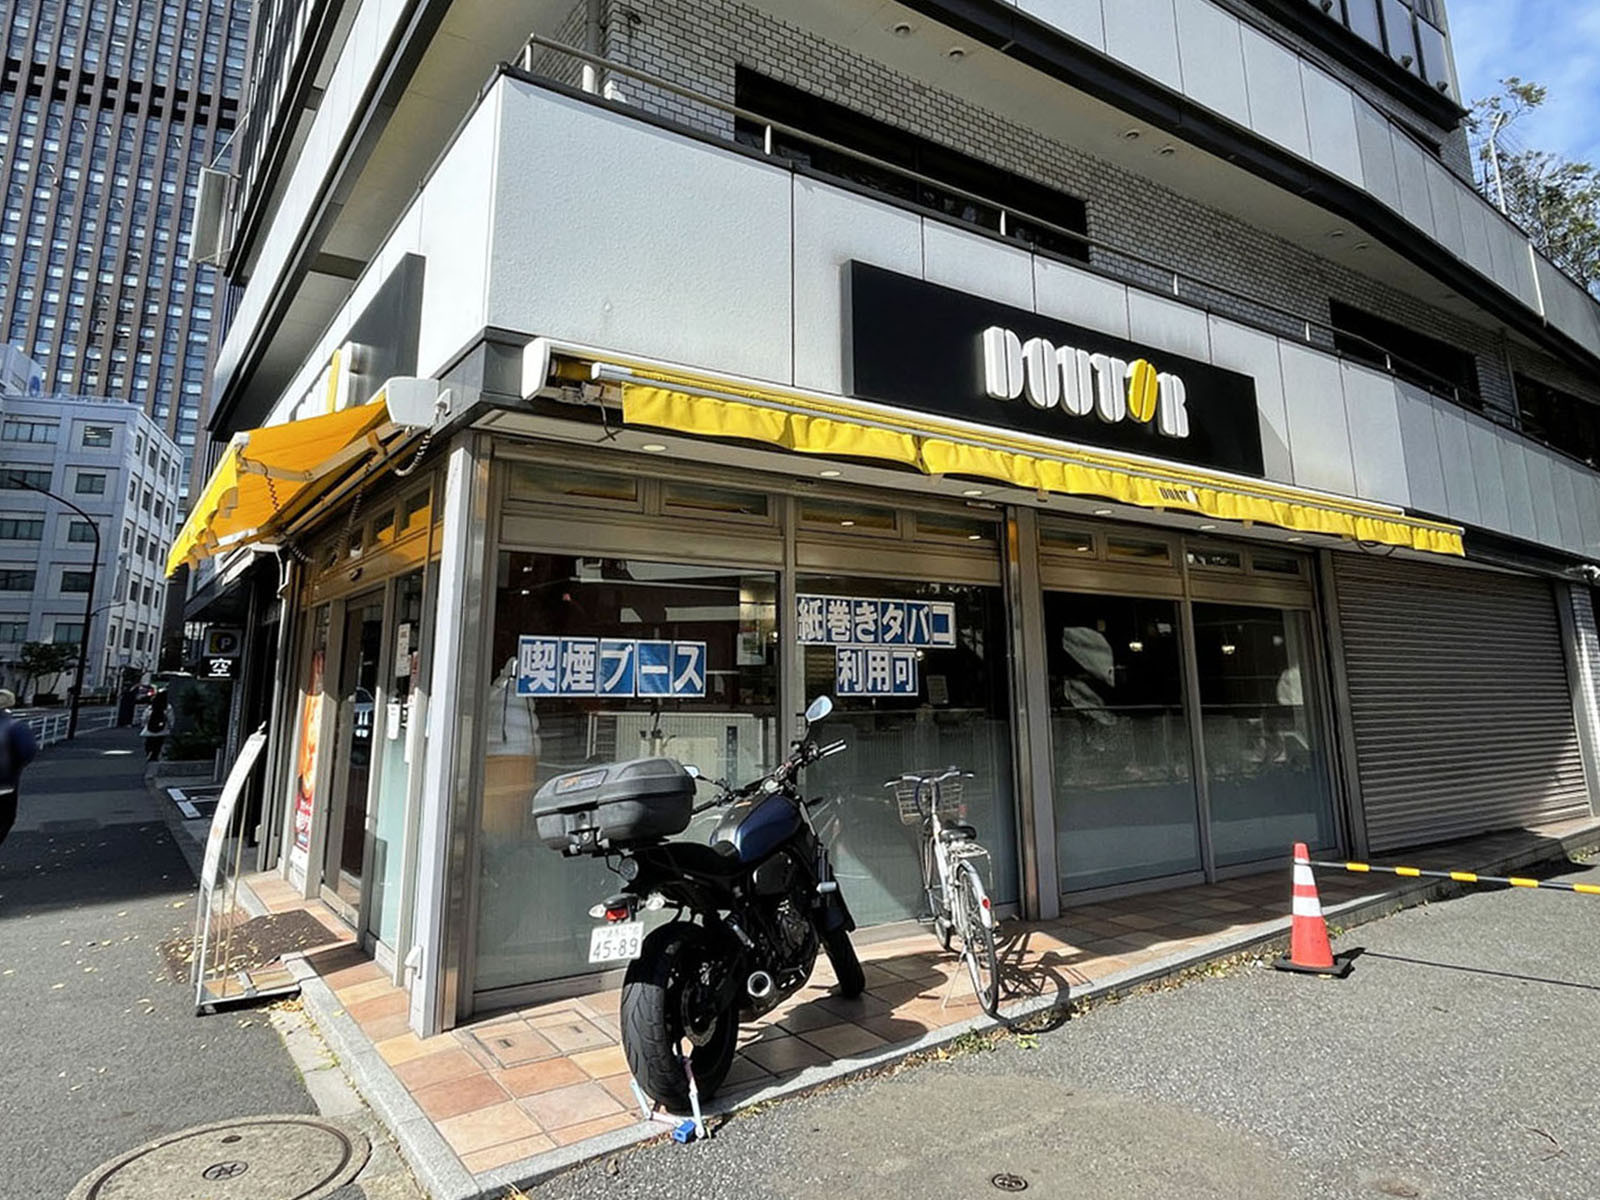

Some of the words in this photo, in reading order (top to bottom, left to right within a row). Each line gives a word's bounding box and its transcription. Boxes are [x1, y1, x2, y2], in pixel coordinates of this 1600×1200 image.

[983, 326, 1190, 438] DOUTOR
[798, 597, 955, 643] 紙巻きタバコ
[208, 658, 232, 677] 空
[520, 641, 703, 692] 喫煙ブース
[838, 650, 915, 692] 利用可
[593, 938, 638, 959] 45-89
